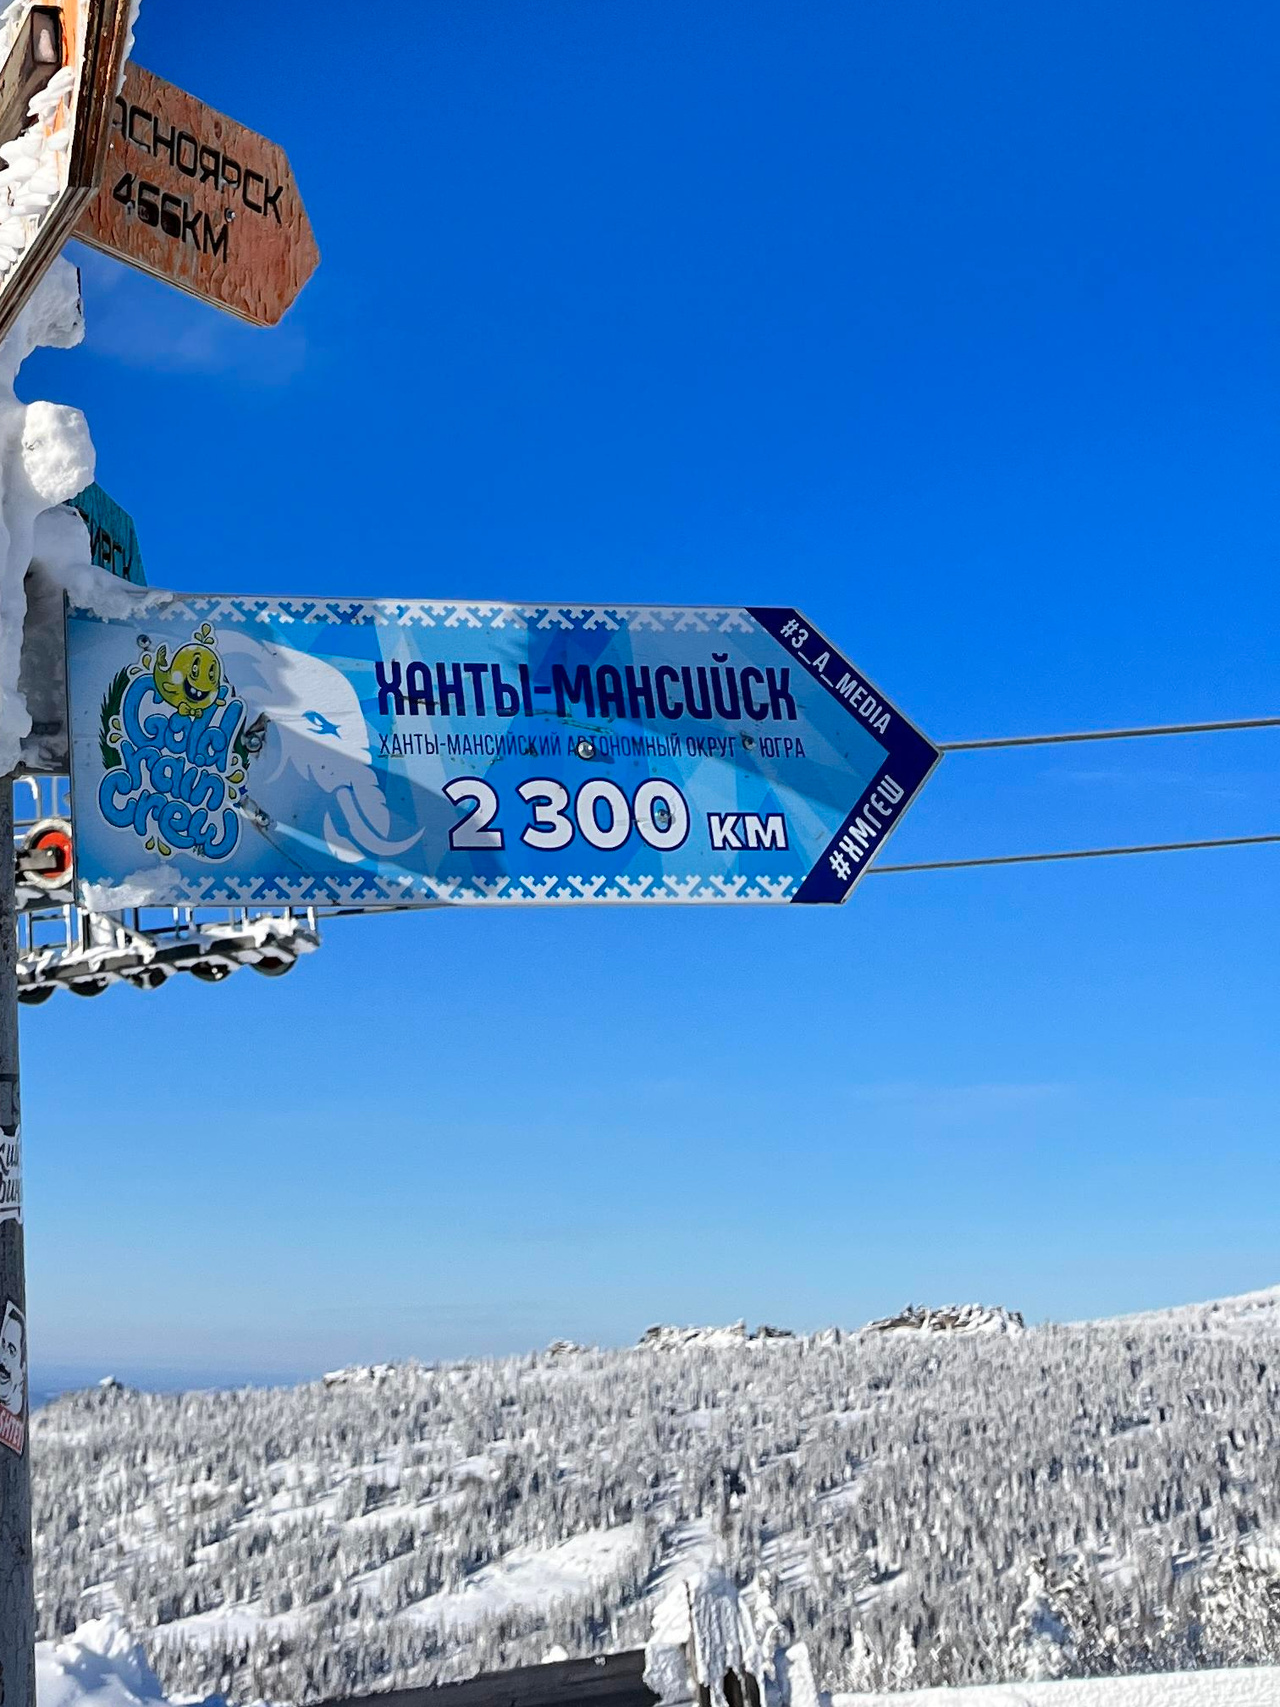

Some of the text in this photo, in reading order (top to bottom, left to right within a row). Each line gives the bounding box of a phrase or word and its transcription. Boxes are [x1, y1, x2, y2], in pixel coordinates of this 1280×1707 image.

[375, 652, 798, 721] ХАНТЫ-МАНСИЙСК
[379, 731, 562, 757] ХАНТЫ-МАНСИЙСКИЙ
[686, 736, 737, 758] ОКРУГ
[759, 737, 807, 759] ЮГРА
